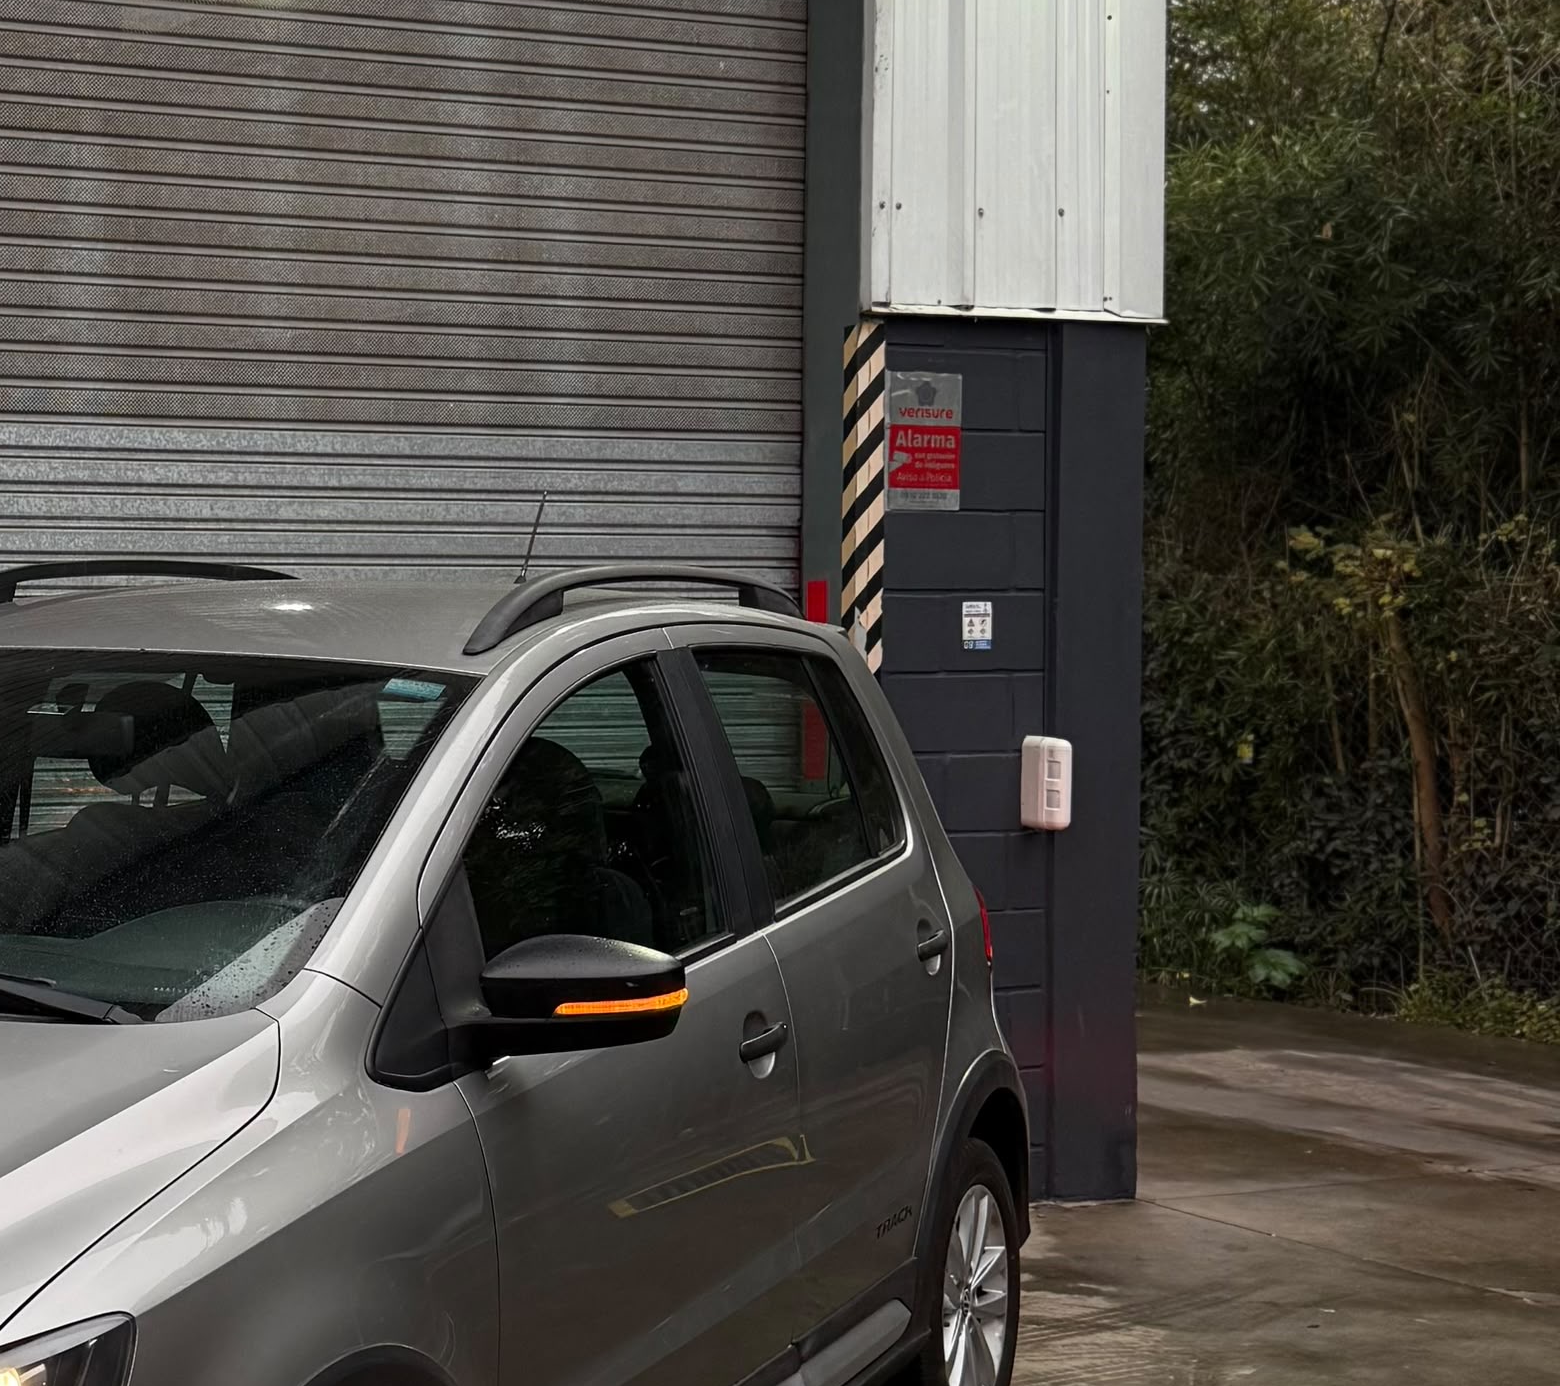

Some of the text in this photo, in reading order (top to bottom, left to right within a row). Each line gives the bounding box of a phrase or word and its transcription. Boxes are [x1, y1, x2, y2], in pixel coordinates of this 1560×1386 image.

[899, 407, 953, 419] verisure
[896, 429, 955, 448] Alarma
[876, 1205, 912, 1239] TRACK
